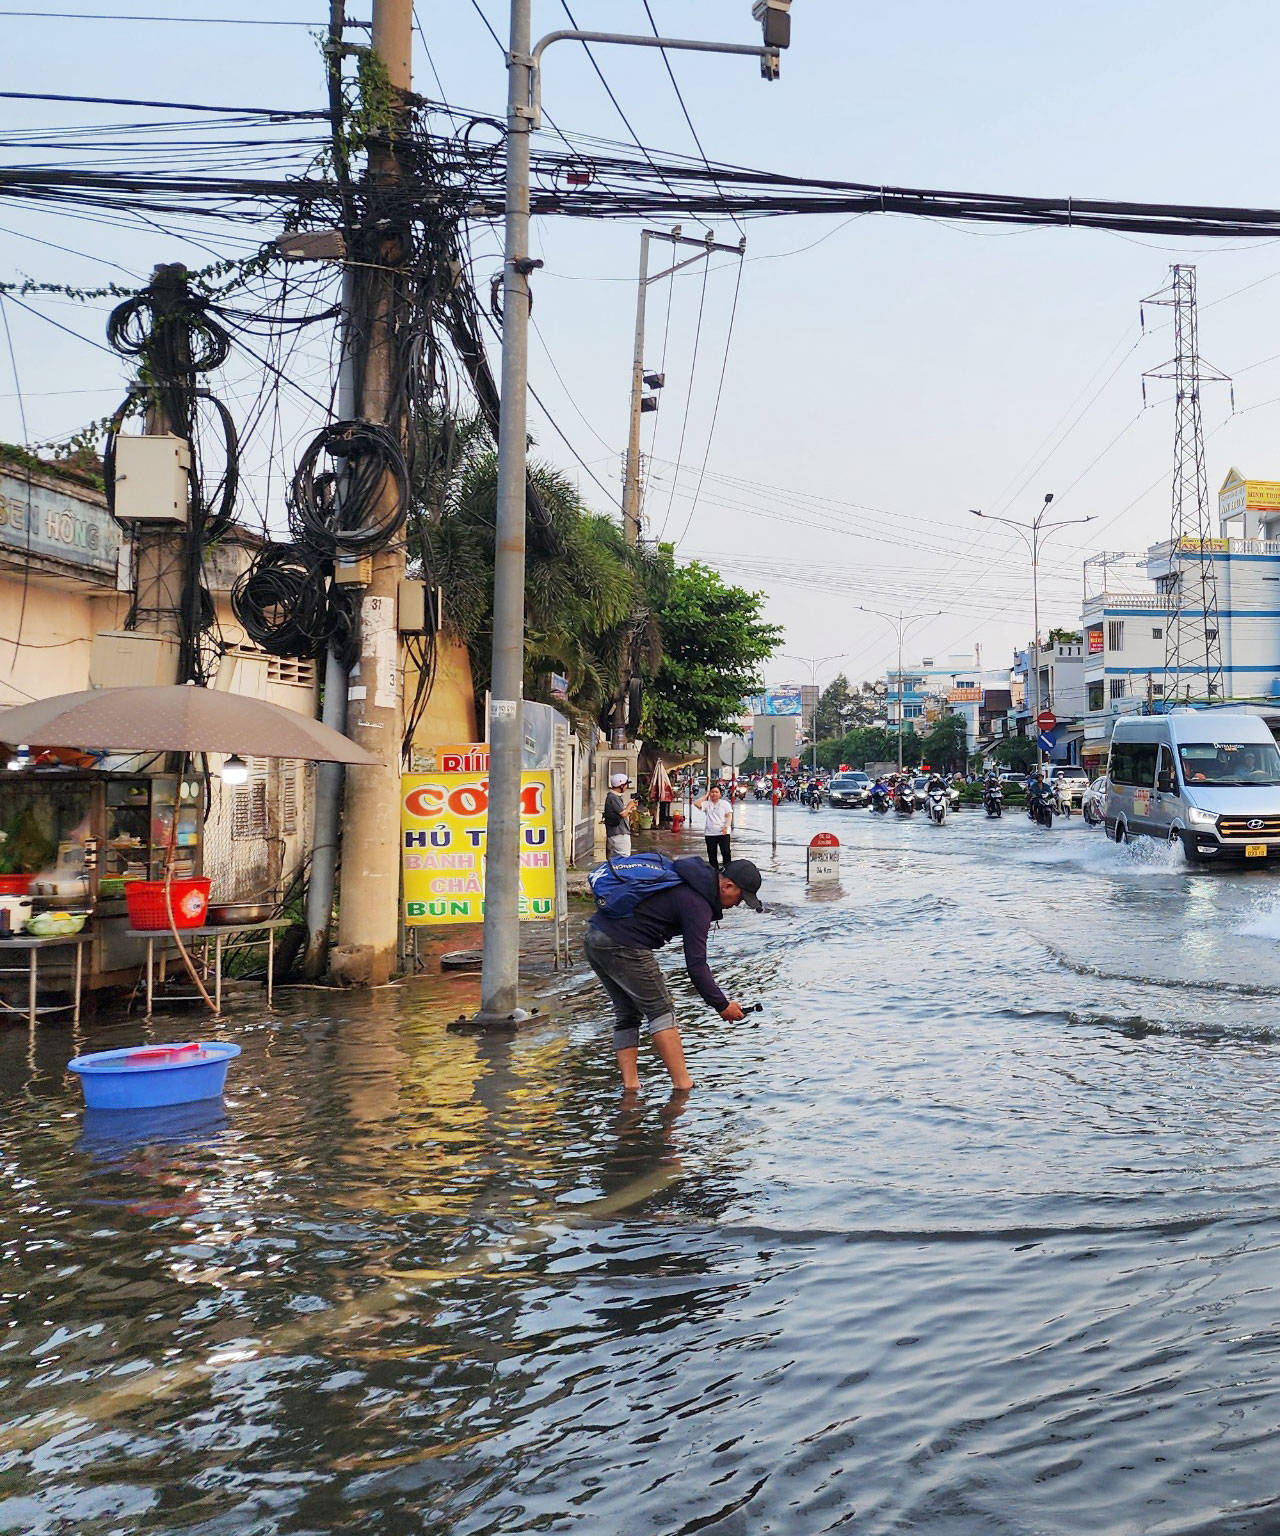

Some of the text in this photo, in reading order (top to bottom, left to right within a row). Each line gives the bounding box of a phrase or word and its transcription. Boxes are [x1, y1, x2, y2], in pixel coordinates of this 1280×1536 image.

[371, 598, 382, 611] 31
[405, 822, 546, 848] HỦ TU
[406, 851, 473, 870] BÁNH
[431, 873, 481, 893] CHẢ
[407, 897, 469, 917] BÚN
